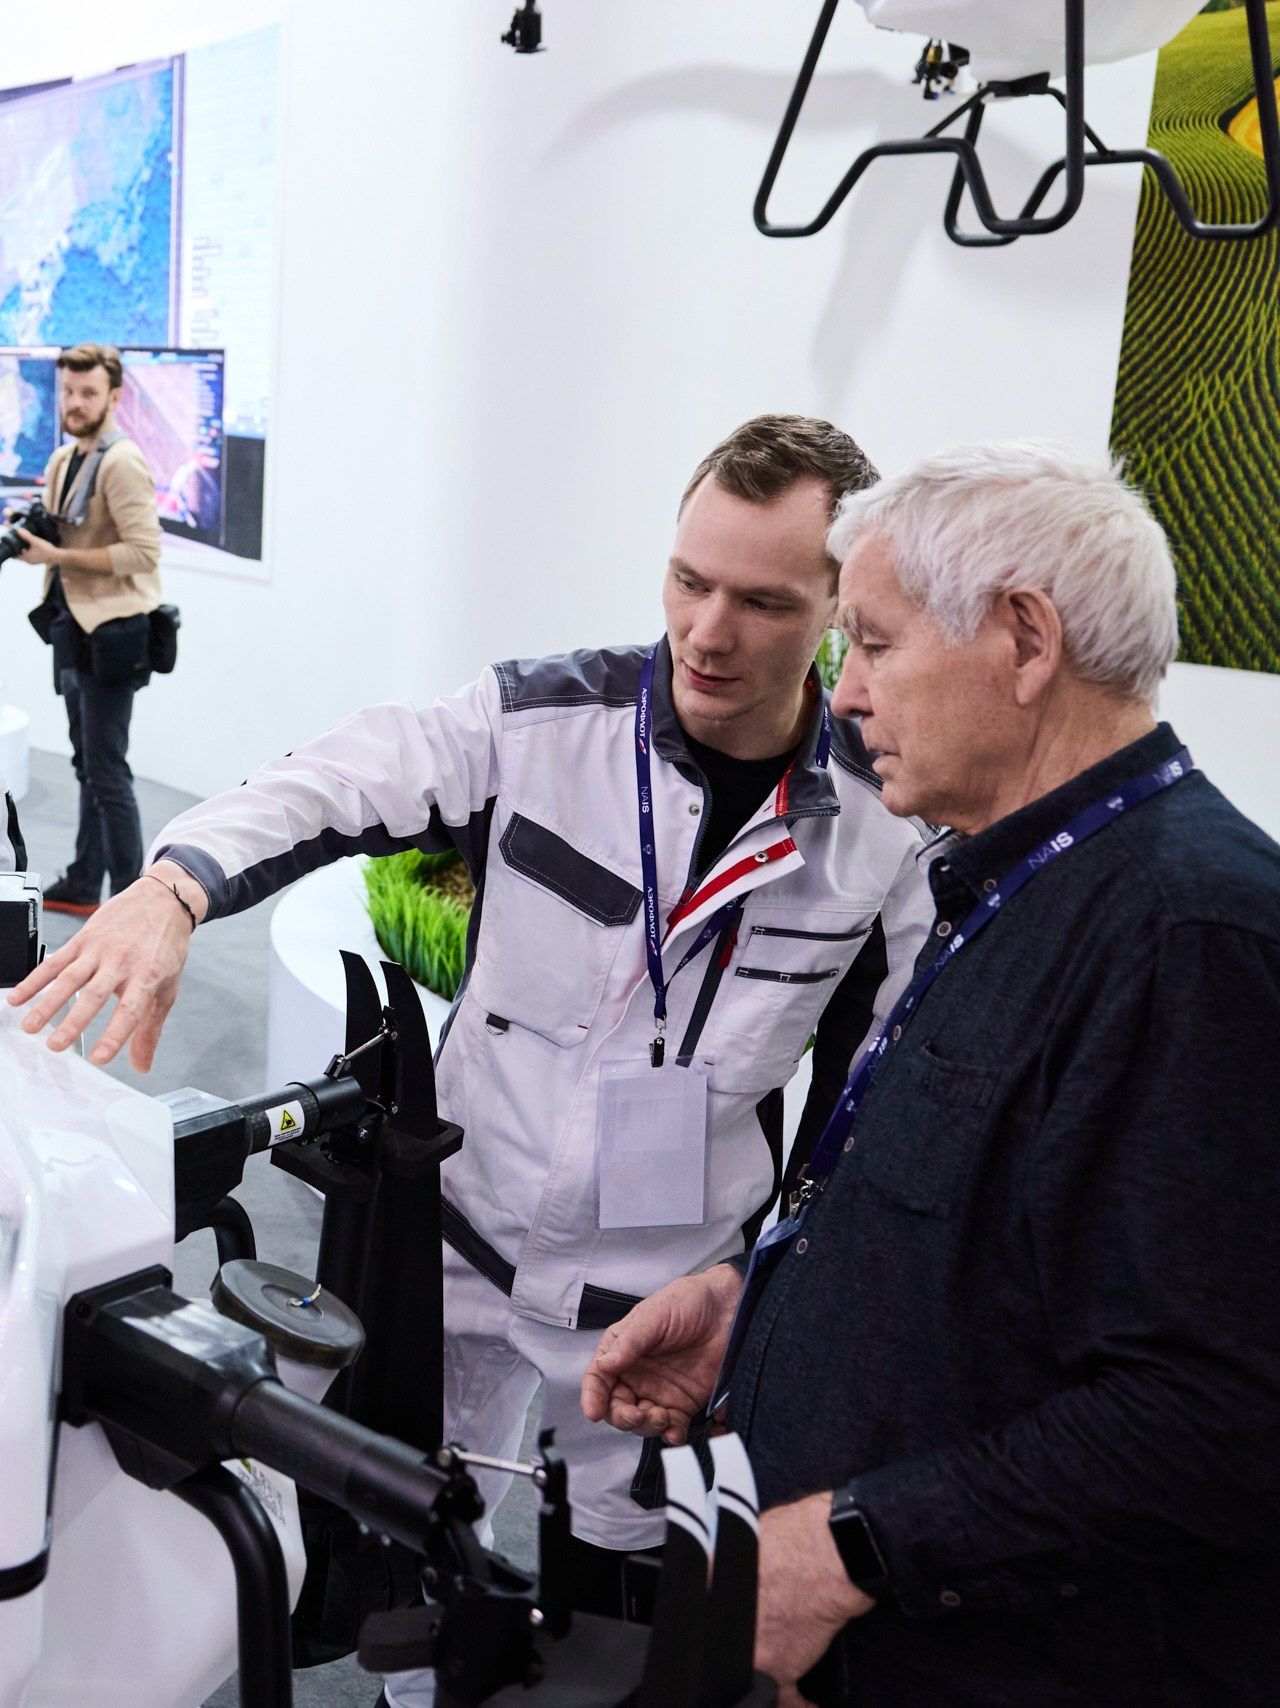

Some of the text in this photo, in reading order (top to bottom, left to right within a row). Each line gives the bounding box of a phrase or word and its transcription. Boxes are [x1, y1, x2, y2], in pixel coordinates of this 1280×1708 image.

[639, 688, 648, 738] АЭРОФЛОТ
[1152, 760, 1183, 786] NAIS
[641, 786, 650, 814] NAIS
[1028, 831, 1074, 870] NAIS
[647, 886, 657, 938] АЭРОФЛОТ
[934, 934, 965, 971] NAIS
